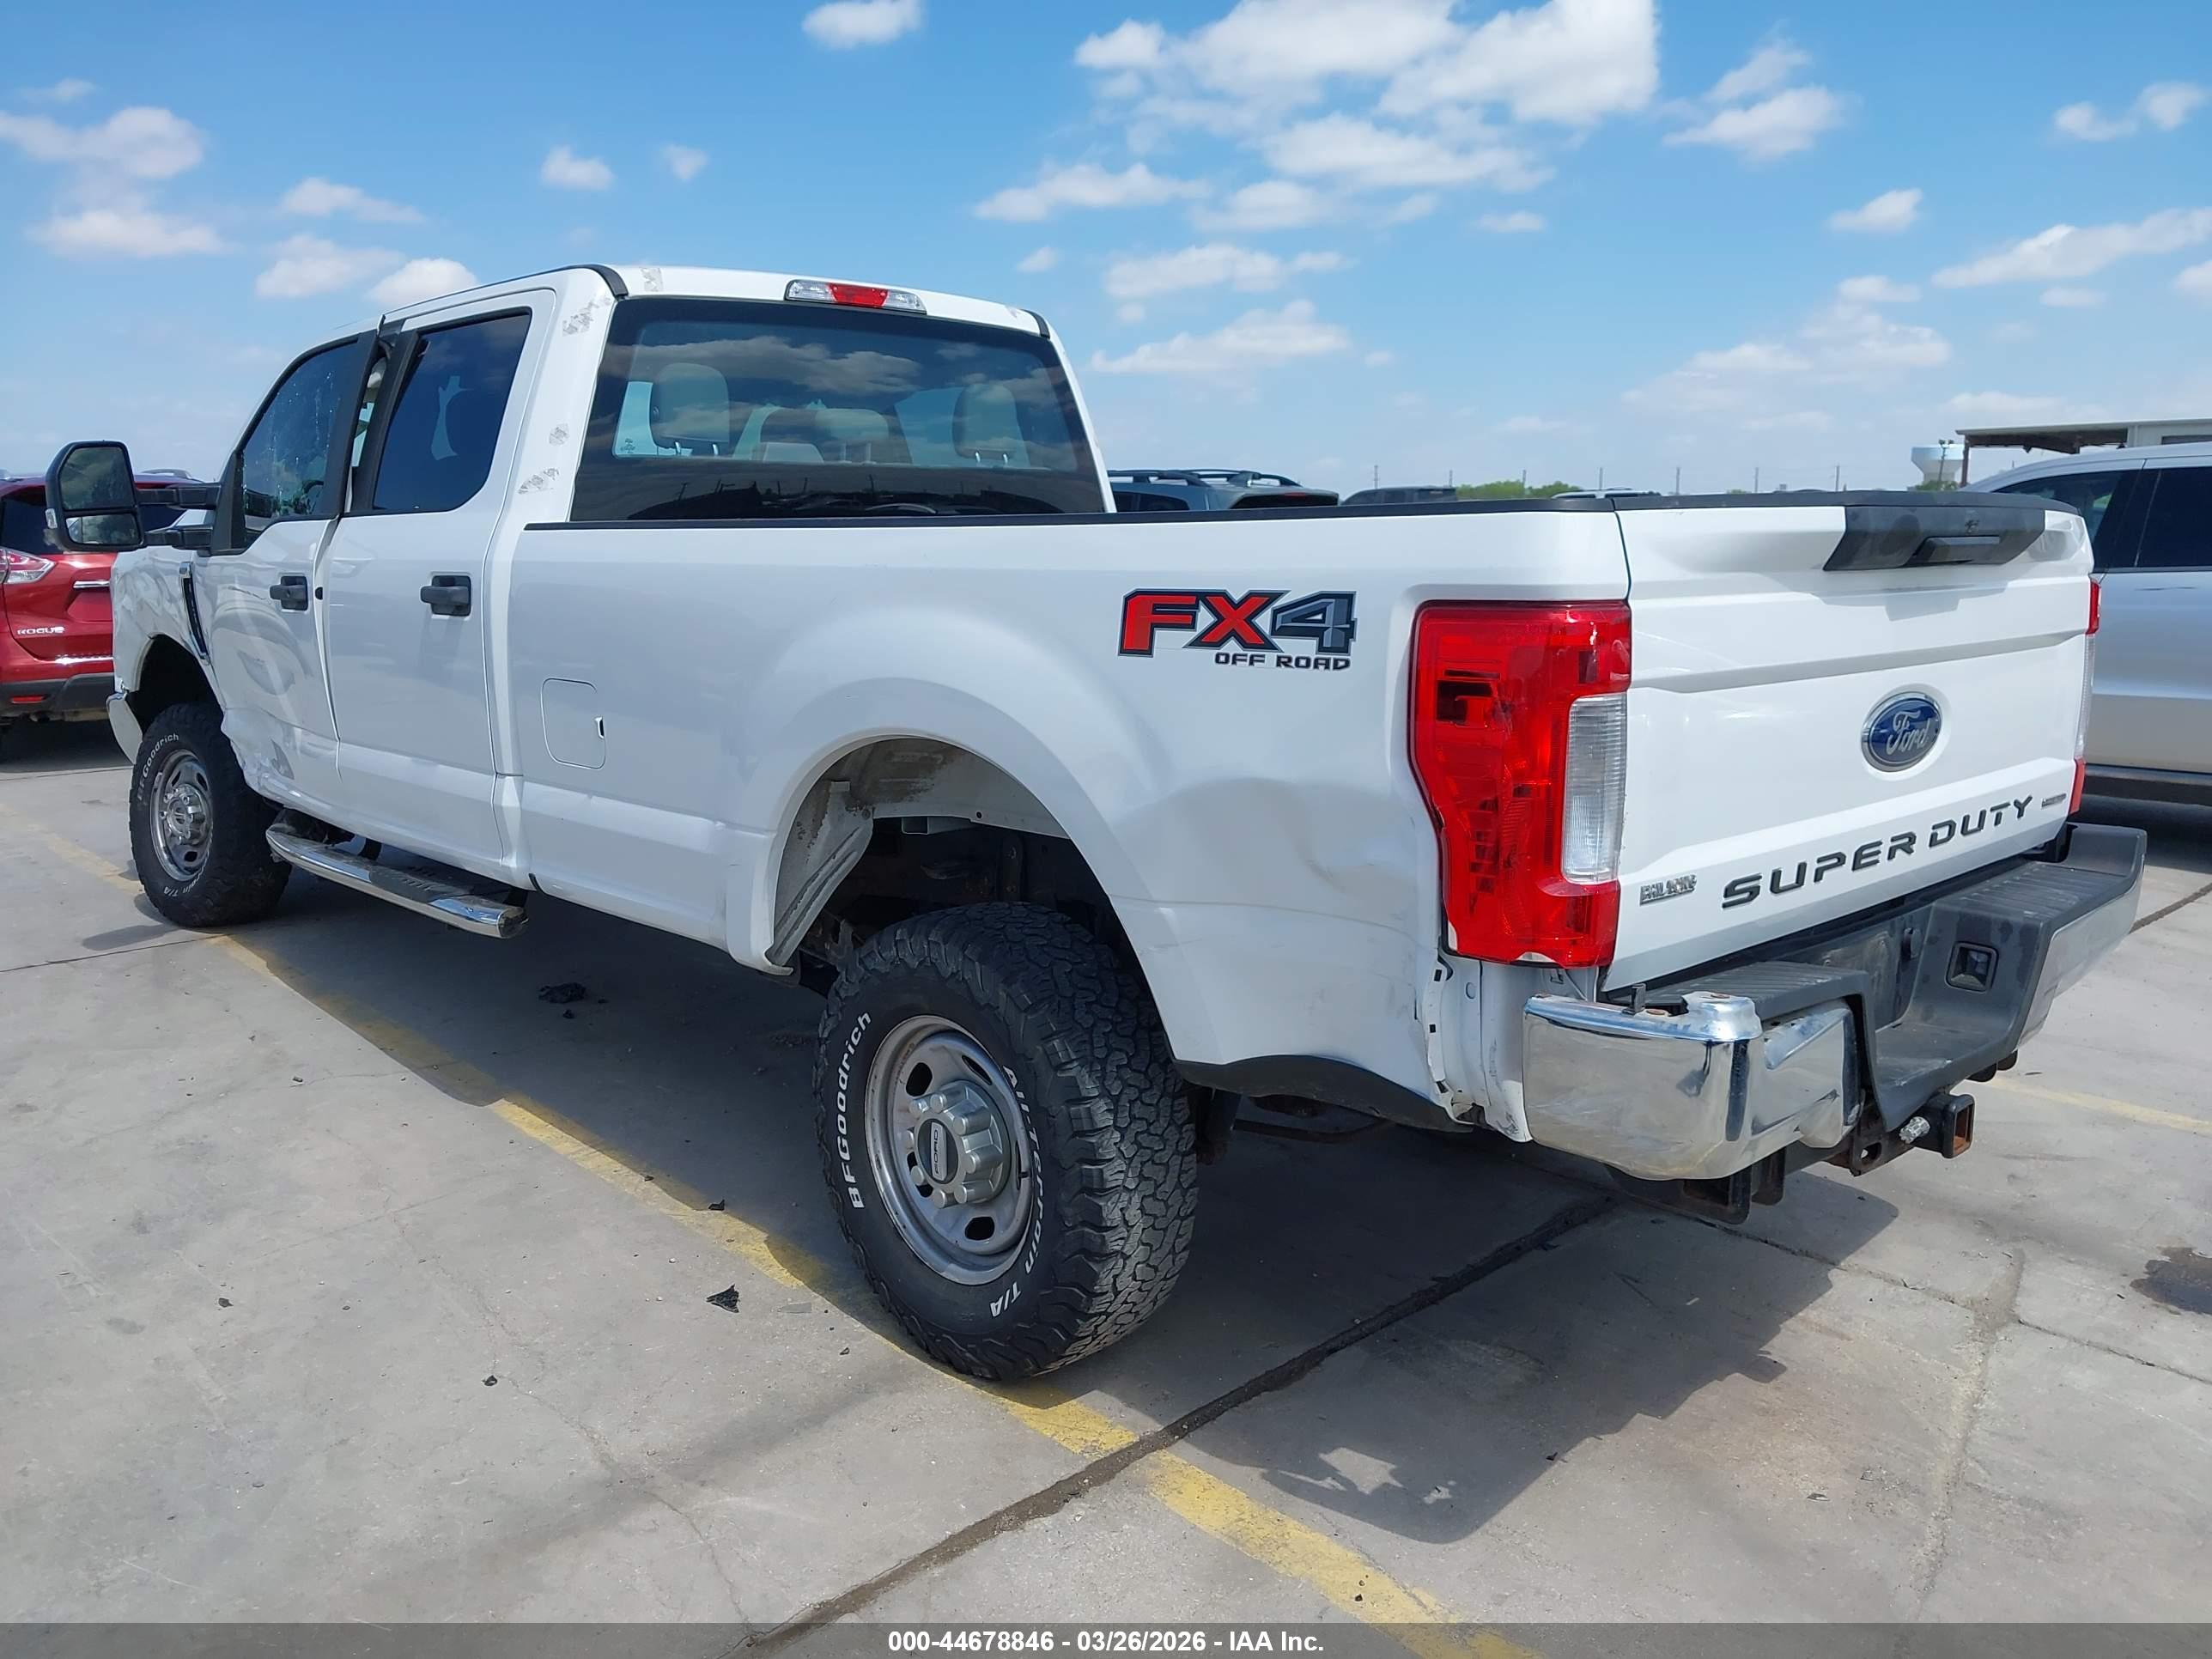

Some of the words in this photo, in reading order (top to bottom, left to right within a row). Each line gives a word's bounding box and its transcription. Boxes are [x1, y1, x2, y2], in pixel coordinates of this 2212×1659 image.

[17, 626, 65, 635] ROGUE
[1117, 588, 1357, 657] FX4
[1214, 653, 1266, 667] OFF
[1276, 653, 1351, 671] ROAD
[1886, 709, 1932, 755] Ford
[1721, 830, 1917, 908] SUPER
[1929, 795, 2033, 848] DUTY
[836, 1012, 872, 1209] BFGoodrich
[989, 1280, 1022, 1317] T/A
